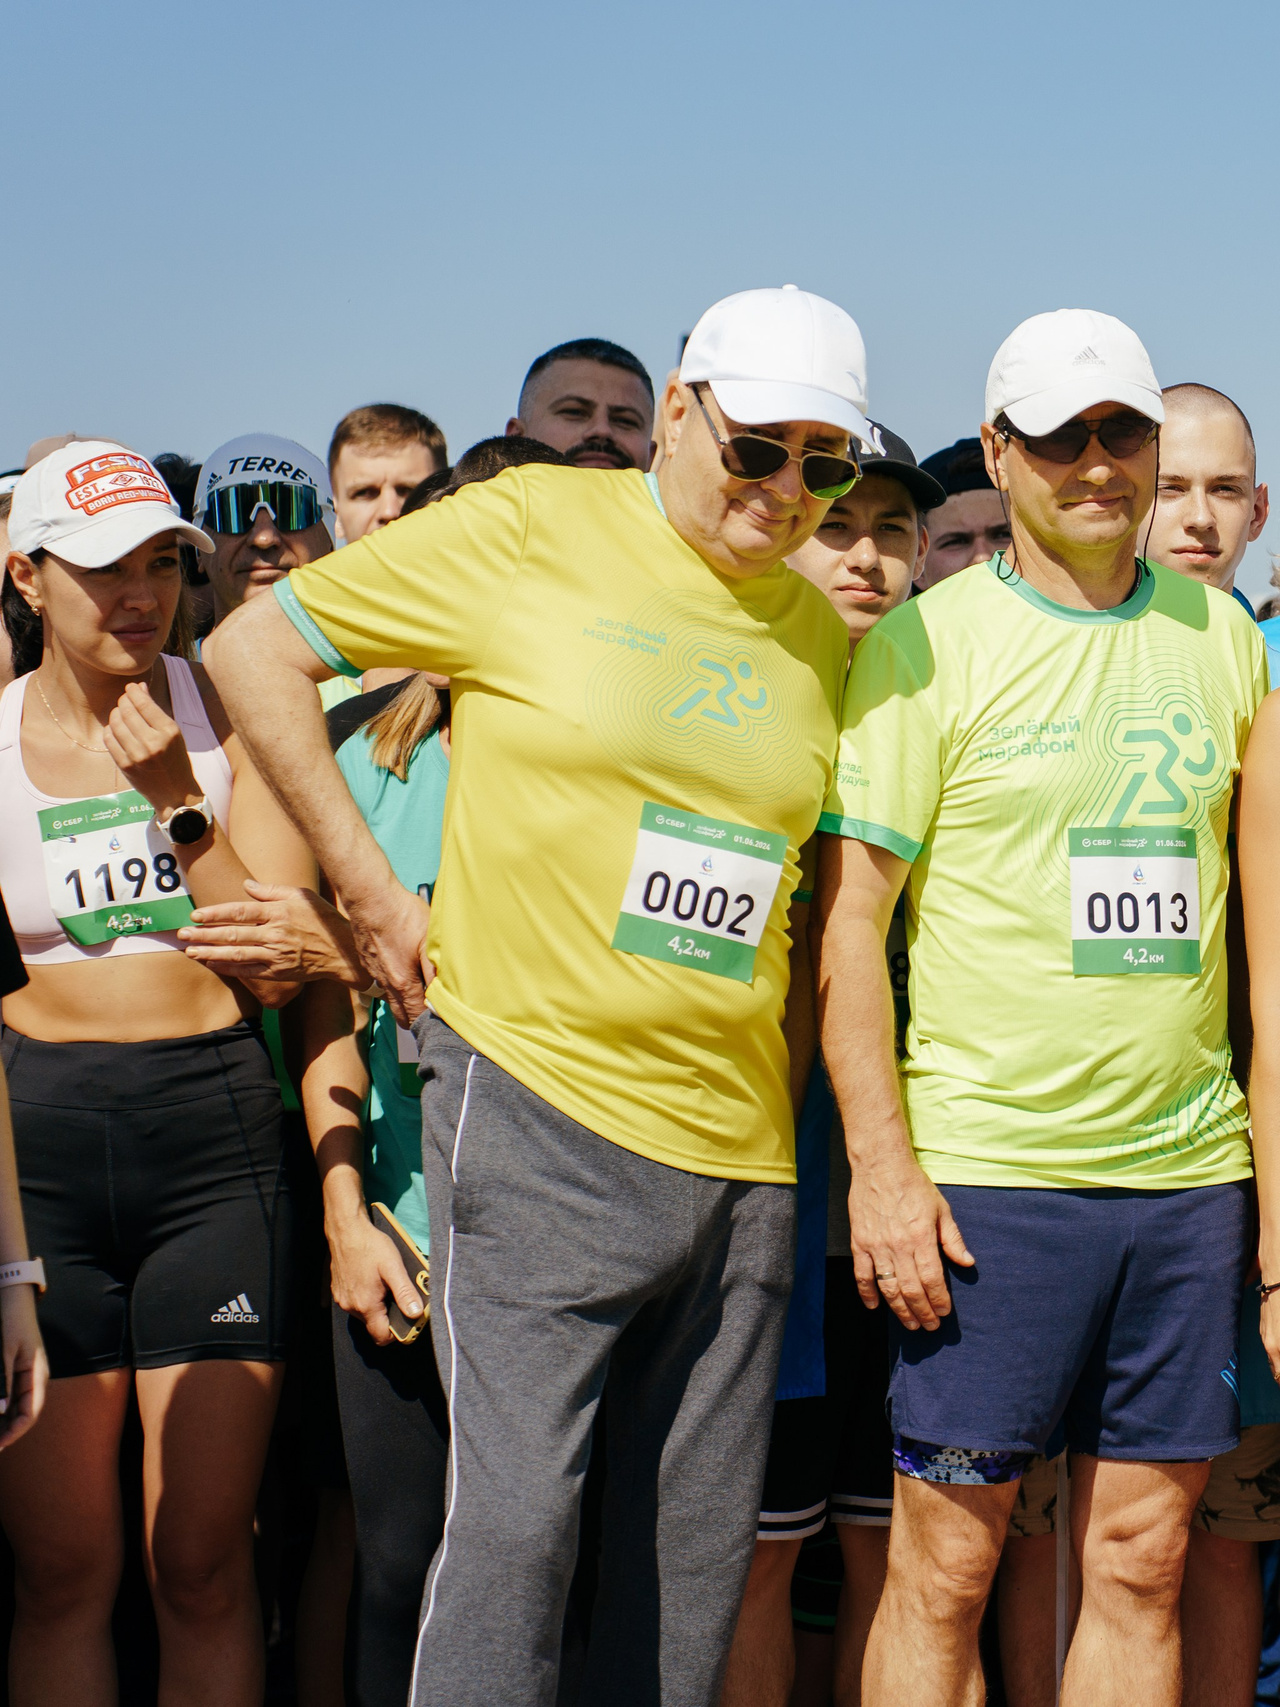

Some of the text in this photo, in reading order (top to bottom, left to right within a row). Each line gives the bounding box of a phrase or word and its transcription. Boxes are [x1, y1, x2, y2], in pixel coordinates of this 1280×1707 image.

[72, 455, 151, 483] FCSM
[75, 482, 105, 502] EST.
[88, 495, 117, 511] BORN
[583, 628, 660, 657] марафон
[989, 715, 1081, 740] зелёный
[978, 737, 1076, 761] марафон
[62, 817, 83, 827] СБЕР
[665, 818, 686, 829] СБЕР
[733, 835, 771, 851] 01.06.2024
[64, 852, 181, 909] 1198
[642, 870, 755, 937] 0002
[1087, 891, 1188, 934] 0013
[210, 1311, 260, 1323] adidas
